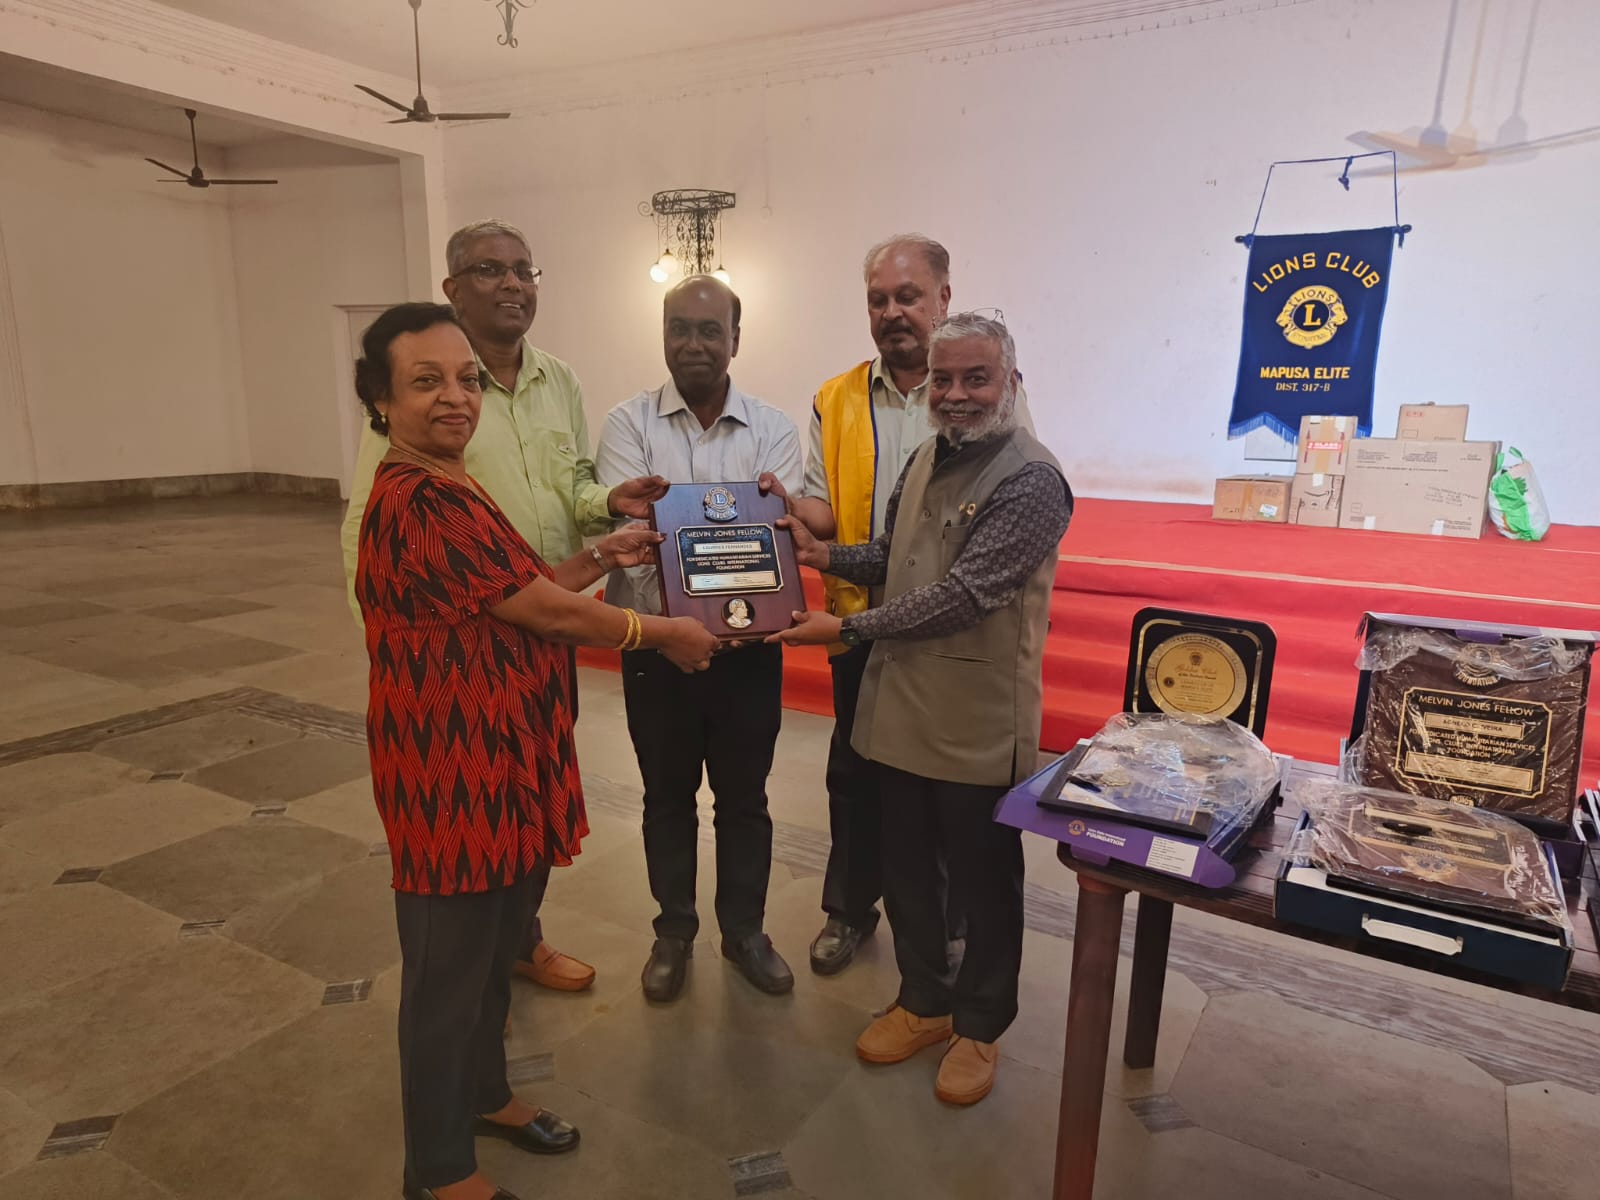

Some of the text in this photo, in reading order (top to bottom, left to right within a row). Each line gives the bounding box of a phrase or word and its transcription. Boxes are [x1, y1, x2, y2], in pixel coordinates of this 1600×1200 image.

[1253, 252, 1380, 292] LIONS CLUB
[1294, 289, 1334, 303] LIONS
[1303, 304, 1321, 326] L
[1260, 367, 1350, 378] MAPUSA ELITE
[1276, 383, 1330, 392] DIST. 317-B
[1419, 695, 1454, 706] MELVIN
[1457, 700, 1490, 711] JONES
[1494, 705, 1534, 716] FELLOW
